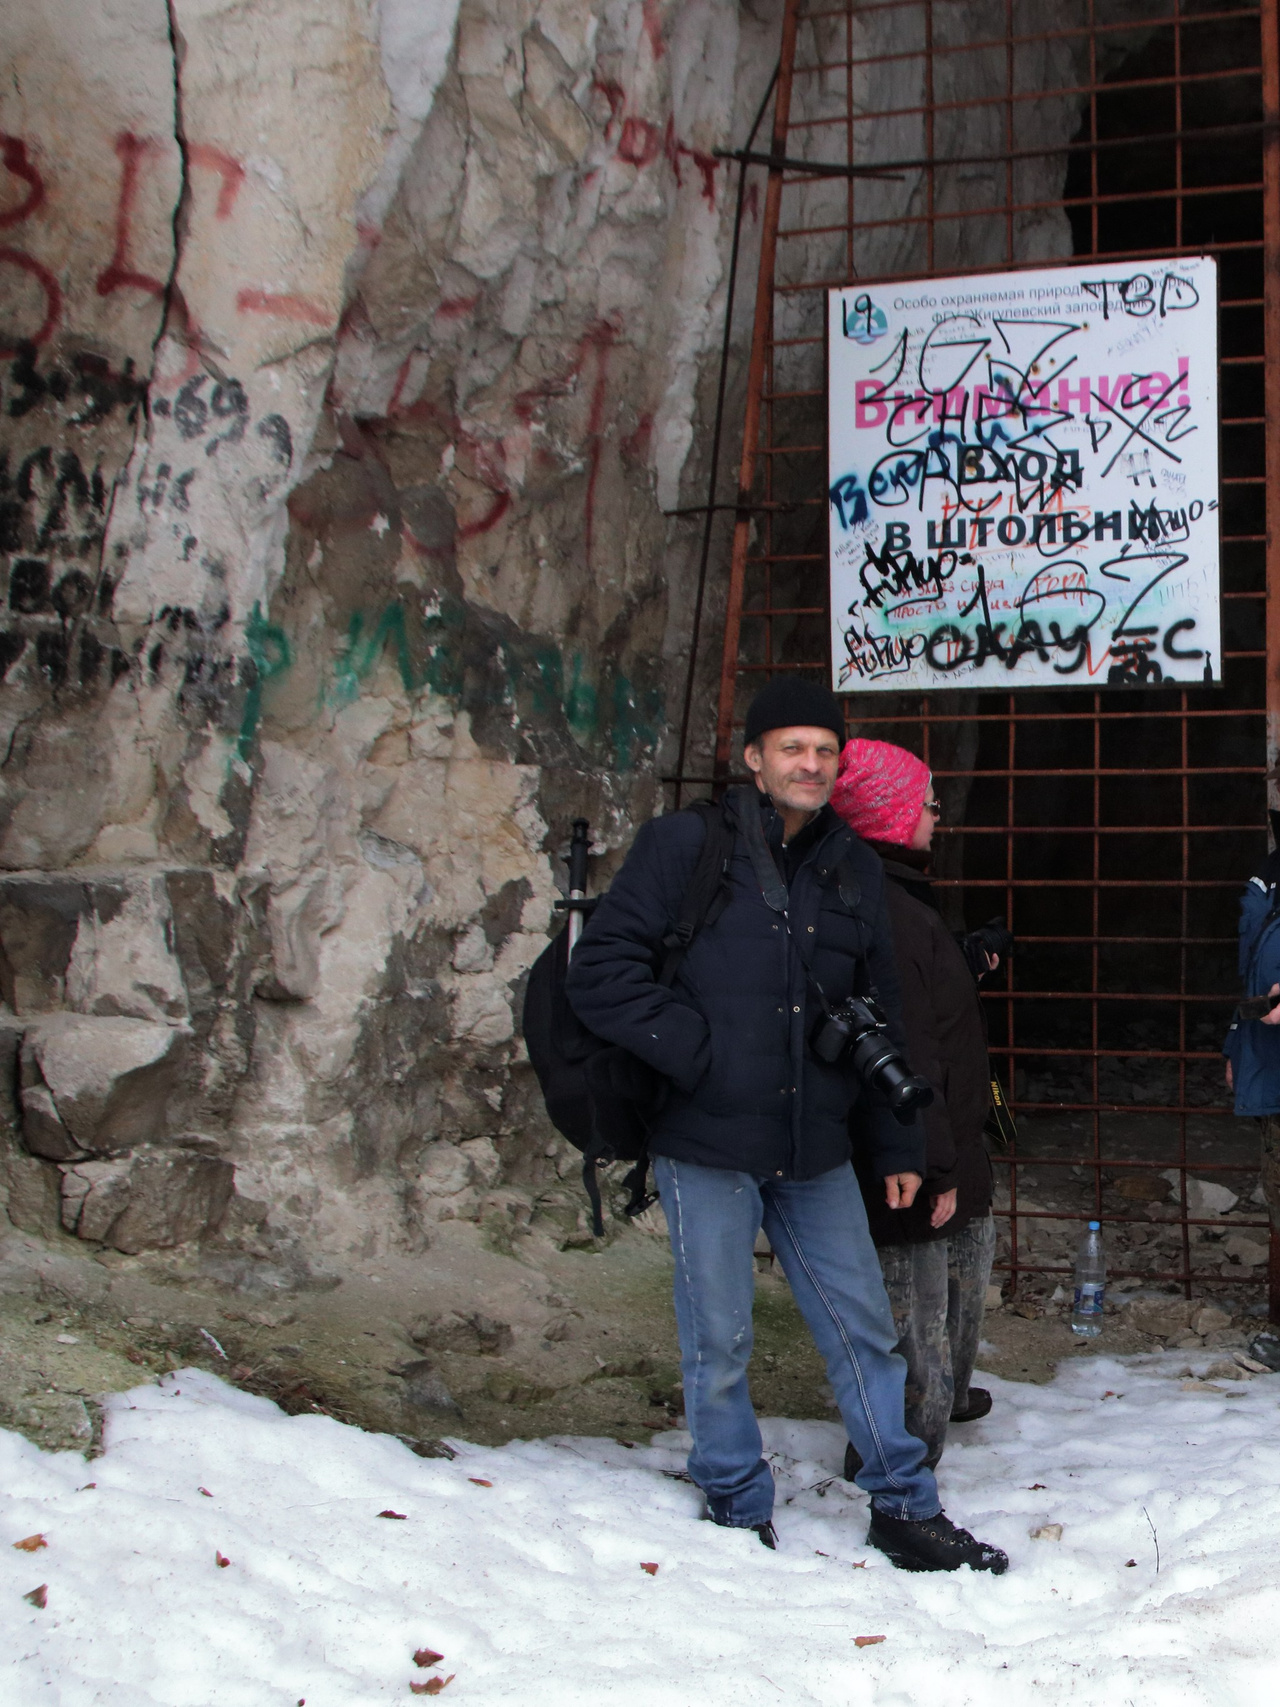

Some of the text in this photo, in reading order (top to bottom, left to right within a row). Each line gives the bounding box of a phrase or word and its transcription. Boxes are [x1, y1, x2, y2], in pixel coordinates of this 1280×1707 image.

[893, 293, 937, 310] Особо
[941, 288, 1025, 308] охраняемая
[1112, 275, 1195, 297] трритория
[854, 356, 1191, 428] Внимание!
